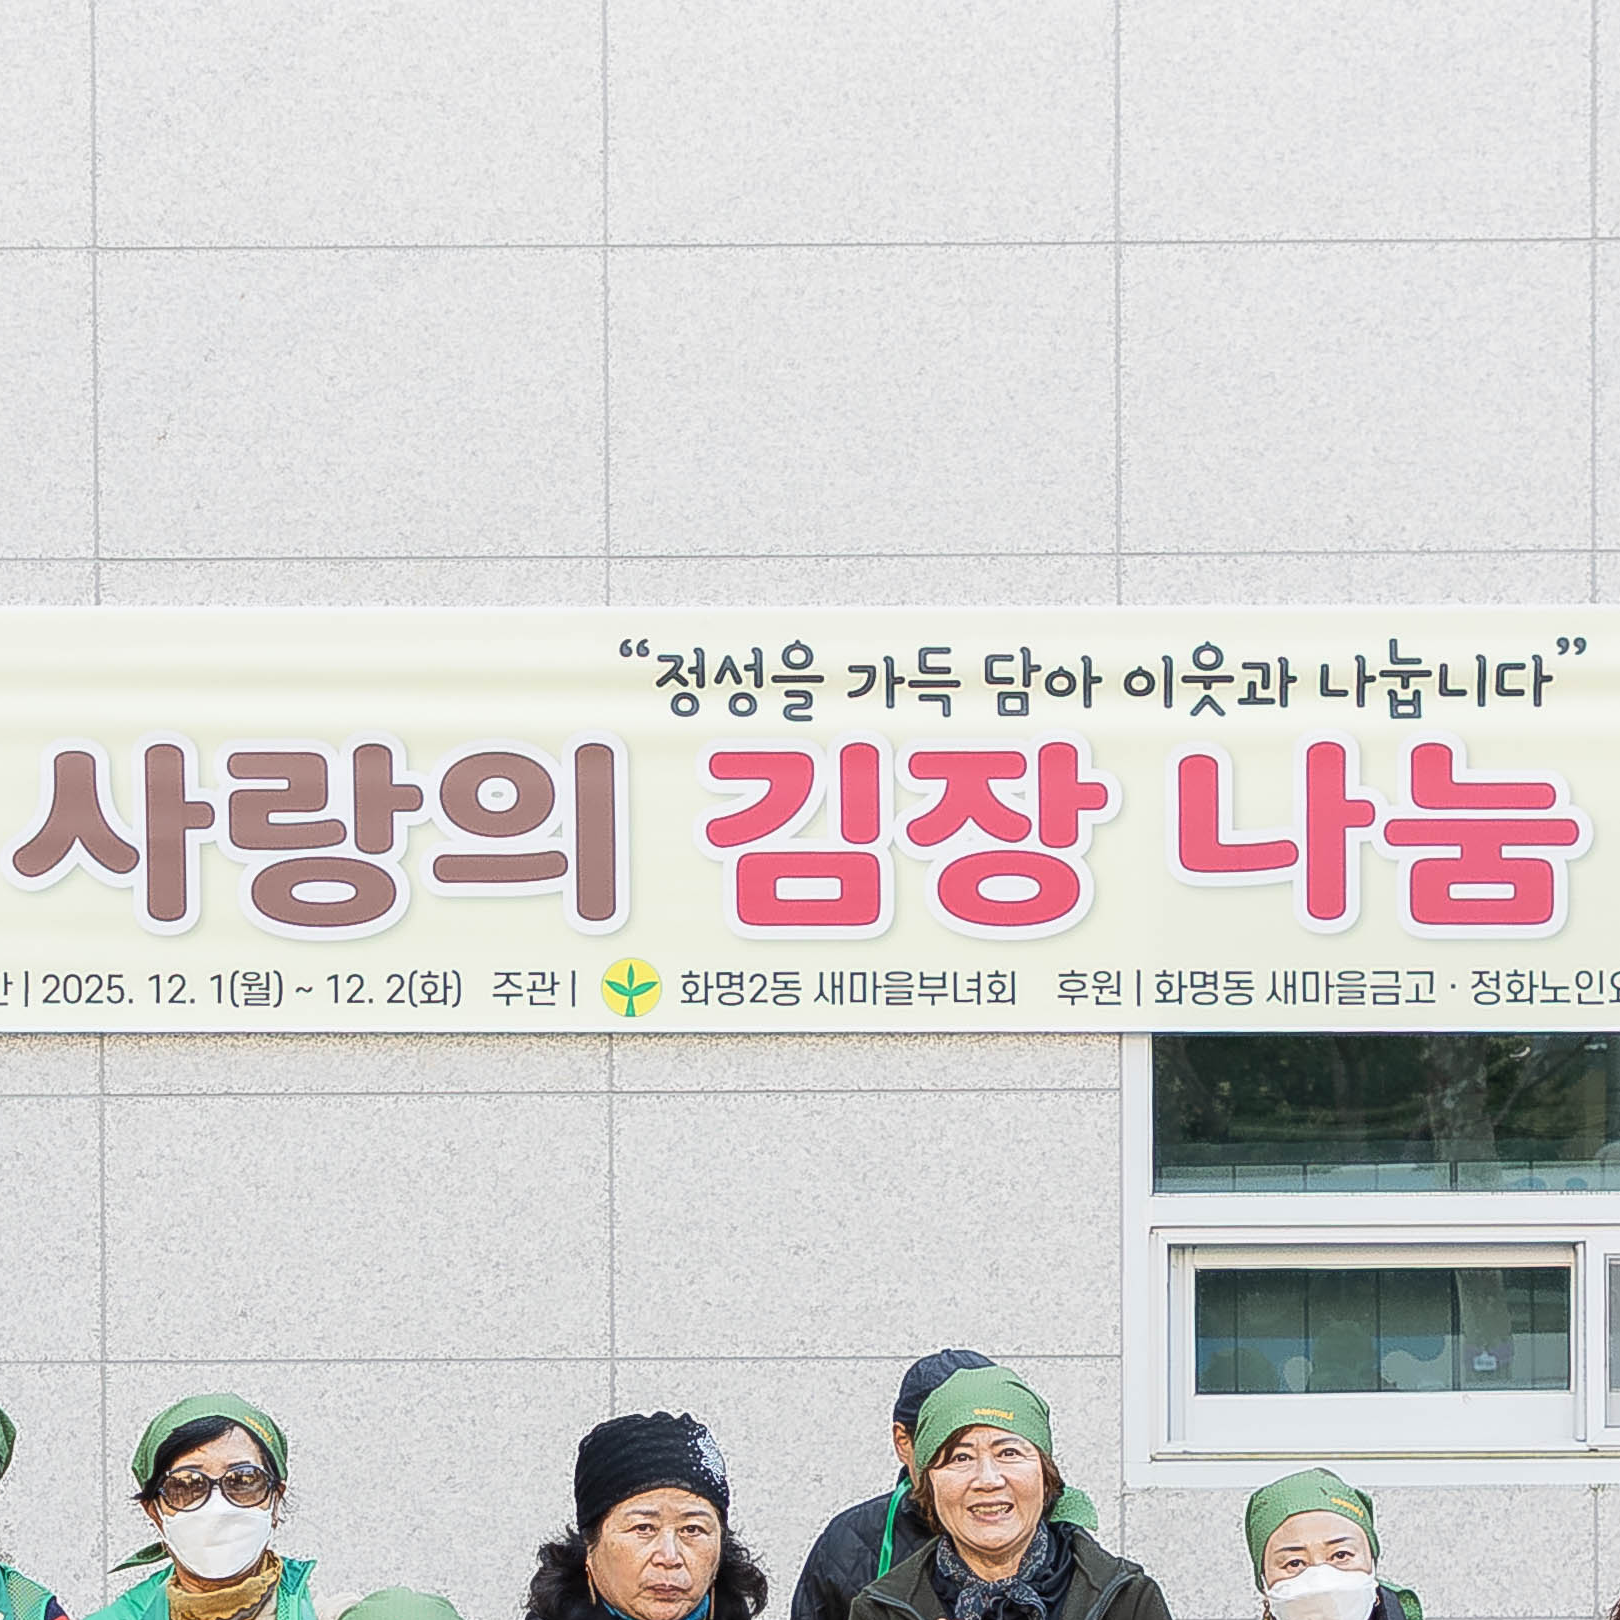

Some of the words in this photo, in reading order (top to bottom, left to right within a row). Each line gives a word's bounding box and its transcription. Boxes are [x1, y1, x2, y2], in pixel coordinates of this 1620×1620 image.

[619, 639, 824, 722] “정성을
[847, 647, 961, 717] 가득
[985, 647, 1102, 716] 담아
[1124, 641, 1297, 716] 이웃과
[1320, 637, 1587, 719] 나눕니다”
[12, 743, 628, 933] 사랑의
[706, 742, 1108, 931] 김장
[1178, 741, 1580, 928] 나눔
[42, 973, 134, 1005] 2025.
[148, 973, 196, 1005] 12.
[210, 970, 283, 1008] 1(월)
[327, 973, 374, 1004] 12.
[387, 970, 462, 1008] 2(화)
[492, 971, 561, 1006] 주관
[680, 970, 803, 1006] 화명2동
[813, 970, 1016, 1006] 새마을부녀회
[1057, 970, 1122, 1006] 후원
[1154, 970, 1255, 1006] 화명동
[1265, 970, 1436, 1006] 새마을금고
